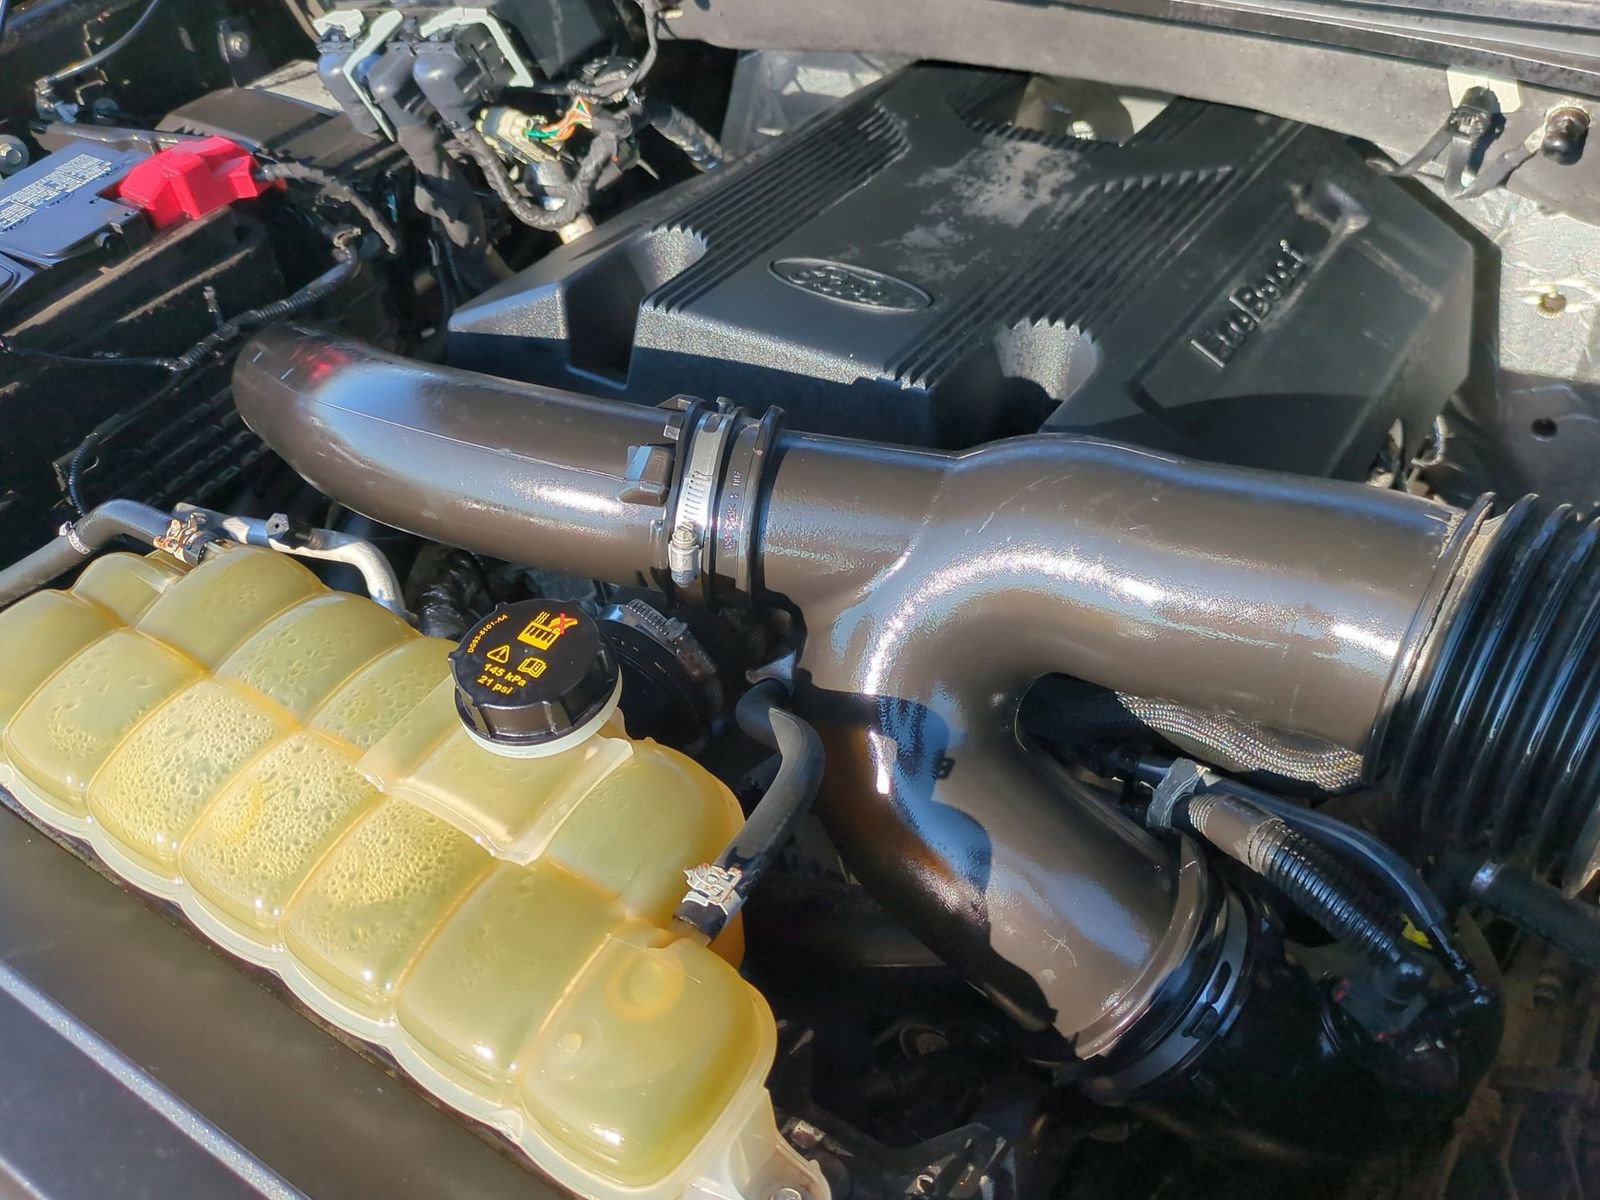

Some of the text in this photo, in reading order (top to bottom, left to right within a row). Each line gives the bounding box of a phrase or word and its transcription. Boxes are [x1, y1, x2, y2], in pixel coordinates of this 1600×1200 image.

[477, 675, 514, 695] 21 psi
[484, 663, 527, 687] 145 kPa
